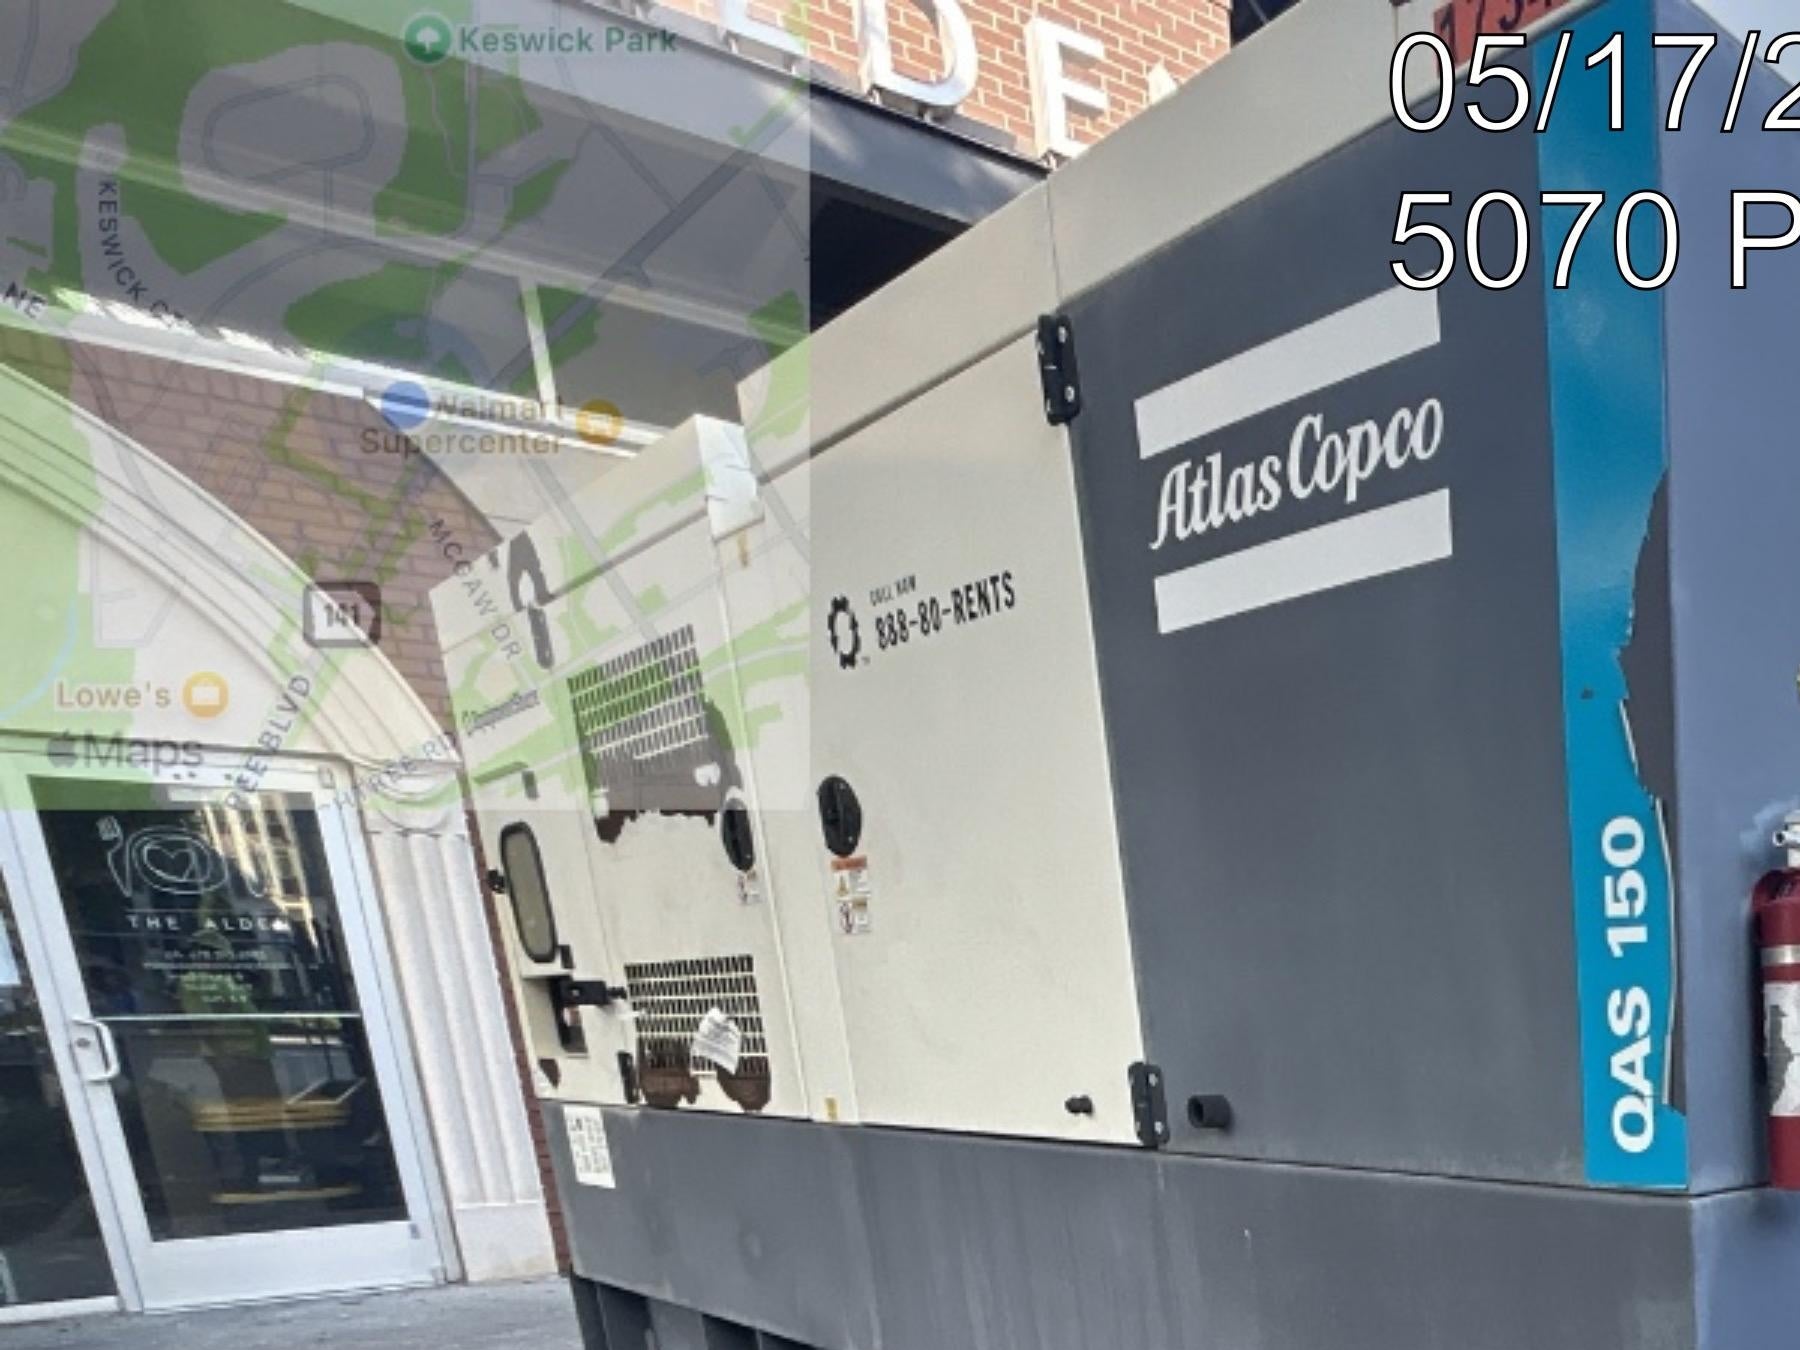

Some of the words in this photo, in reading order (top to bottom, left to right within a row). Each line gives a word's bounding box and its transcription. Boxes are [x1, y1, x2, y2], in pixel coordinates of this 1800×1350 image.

[1149, 451, 1283, 550] Atlas
[1286, 397, 1446, 504] Copco
[874, 569, 1016, 651] 888-80-RENTS
[126, 914, 181, 932] THE
[1600, 815, 1649, 958] 150
[1606, 985, 1656, 1153] QAS
